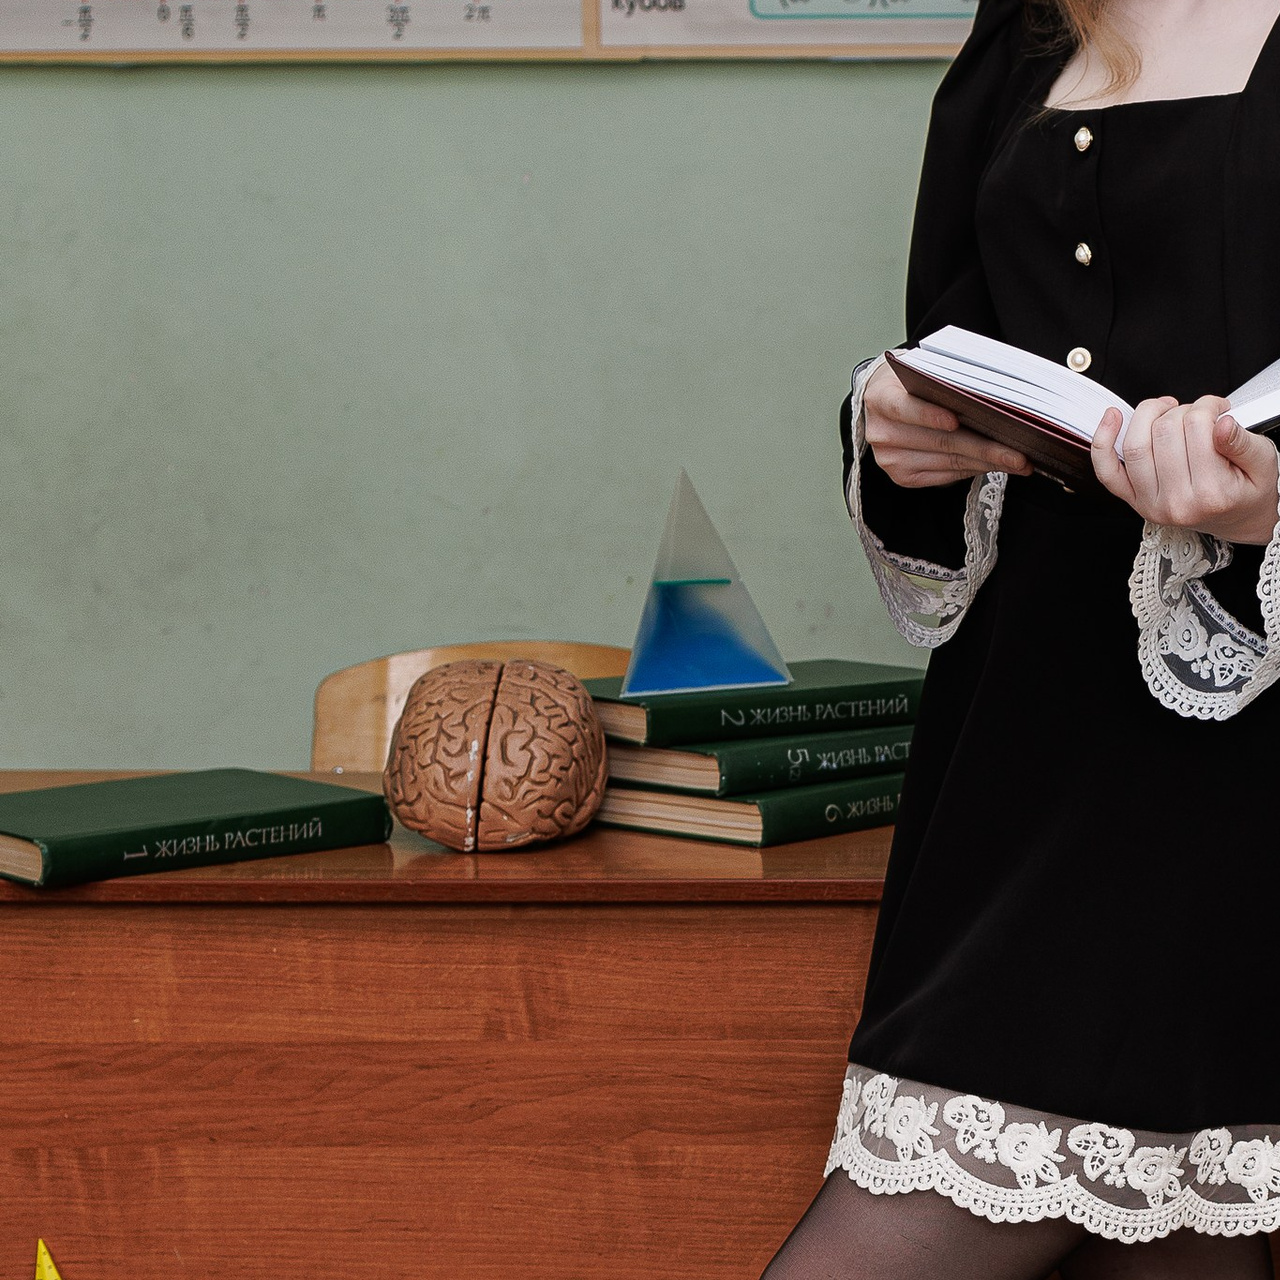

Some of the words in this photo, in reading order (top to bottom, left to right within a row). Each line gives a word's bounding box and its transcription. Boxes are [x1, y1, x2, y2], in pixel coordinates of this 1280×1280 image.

[750, 704, 811, 726] ЖИЗНЬ
[815, 694, 909, 720] РАСТЕНИЙ
[816, 746, 871, 770] ЖИЗНЬ
[847, 794, 894, 819] ЖИЗНЬ
[154, 831, 220, 858] ЖИЗНЬ
[224, 817, 323, 850] РАСТЕНИЙ
